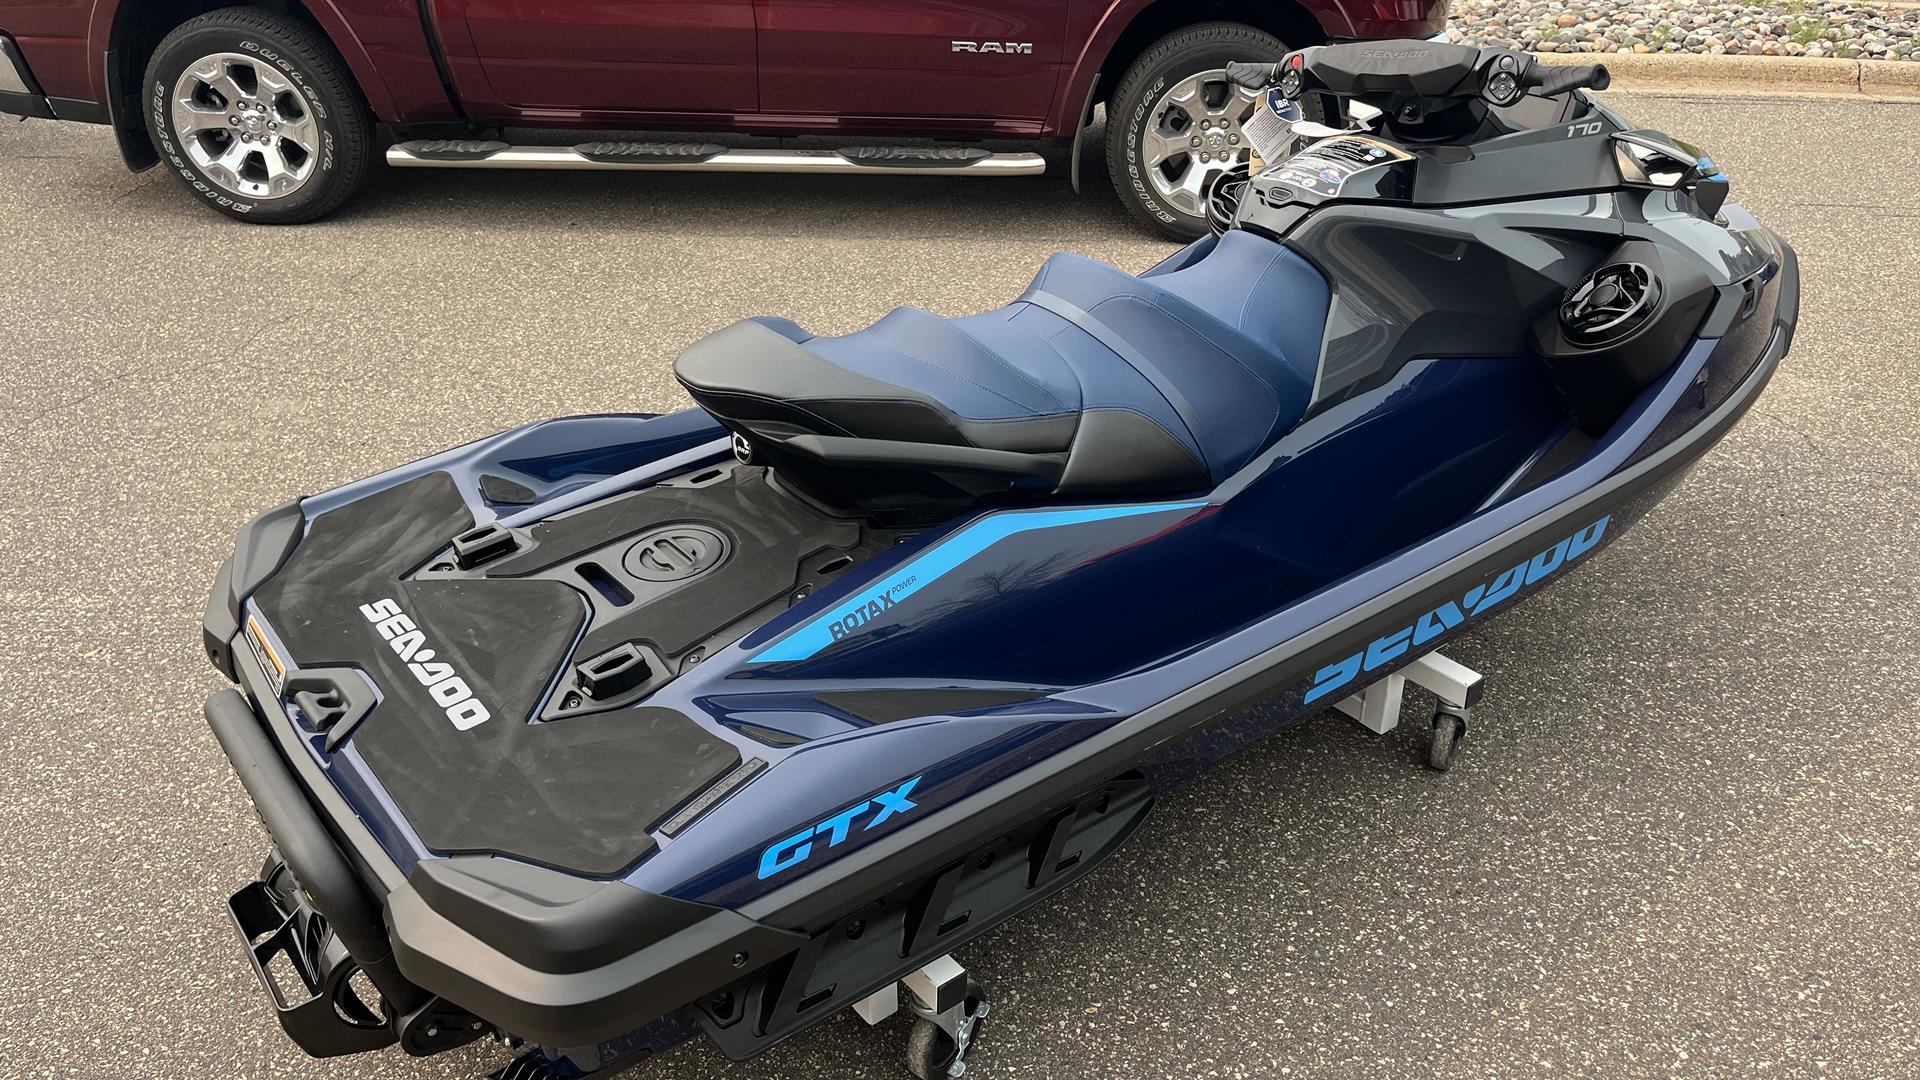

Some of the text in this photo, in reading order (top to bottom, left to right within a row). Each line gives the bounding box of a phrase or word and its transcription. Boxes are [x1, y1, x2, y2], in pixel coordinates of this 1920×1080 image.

[240, 40, 327, 120] DUELER
[952, 41, 1032, 54] RAM
[154, 80, 253, 214] BRIDGESTONE
[1126, 76, 1177, 225] BRIDGESTONE
[1567, 121, 1603, 138] 170
[828, 575, 917, 642] ROTAX POWER
[757, 774, 924, 881] GTX
